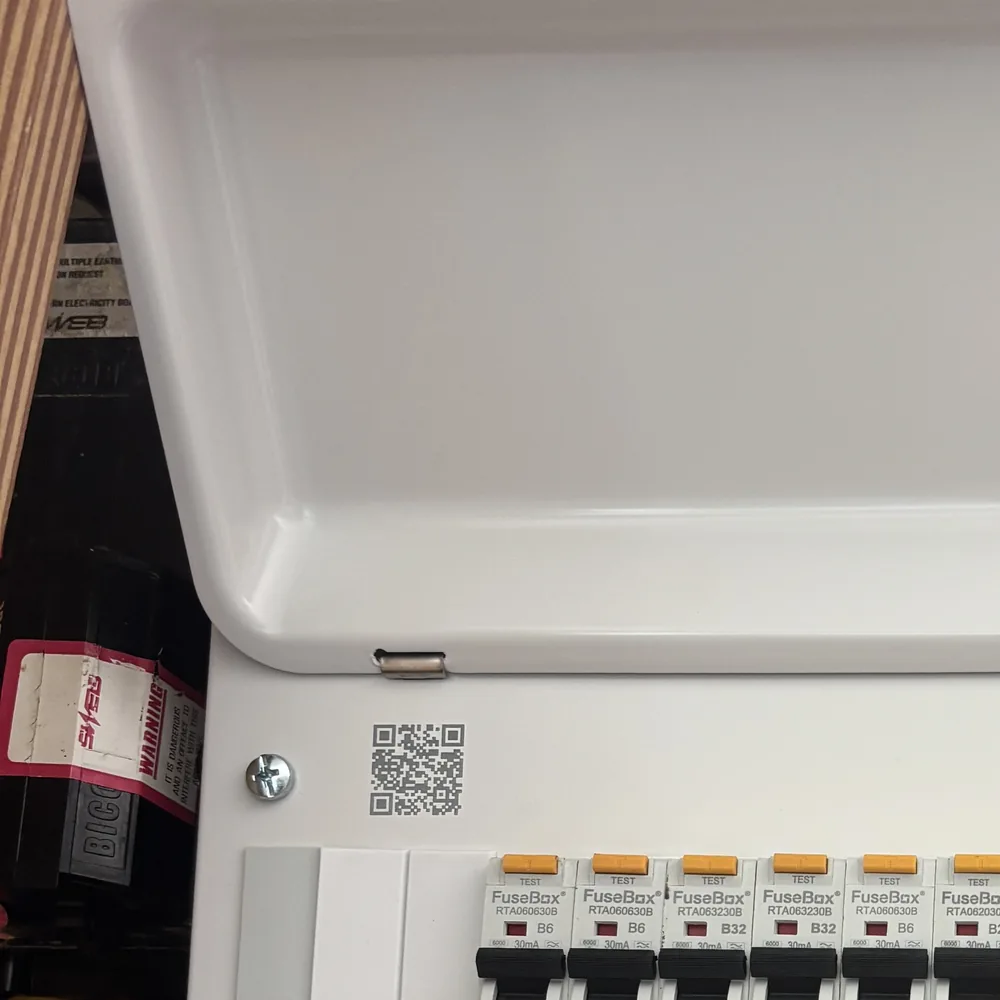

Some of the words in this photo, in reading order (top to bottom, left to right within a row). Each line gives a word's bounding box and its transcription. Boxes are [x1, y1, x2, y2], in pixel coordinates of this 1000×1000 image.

[139, 682, 163, 777] WARNING
[168, 706, 181, 761] DANGEROUS
[172, 776, 181, 796] AND
[611, 877, 635, 885] TEST
[703, 877, 725, 885] TEST
[792, 876, 815, 884] TEST
[496, 907, 557, 916] RTA060630B
[589, 906, 653, 916] RTA060630B
[678, 908, 742, 916] RTA063230B
[768, 906, 832, 916] RTA063230B
[856, 907, 917, 915] RTA060630B
[538, 924, 553, 933] B6
[628, 923, 645, 933] B6
[721, 924, 746, 934] B32
[811, 924, 836, 934] B32
[898, 923, 914, 933] B6
